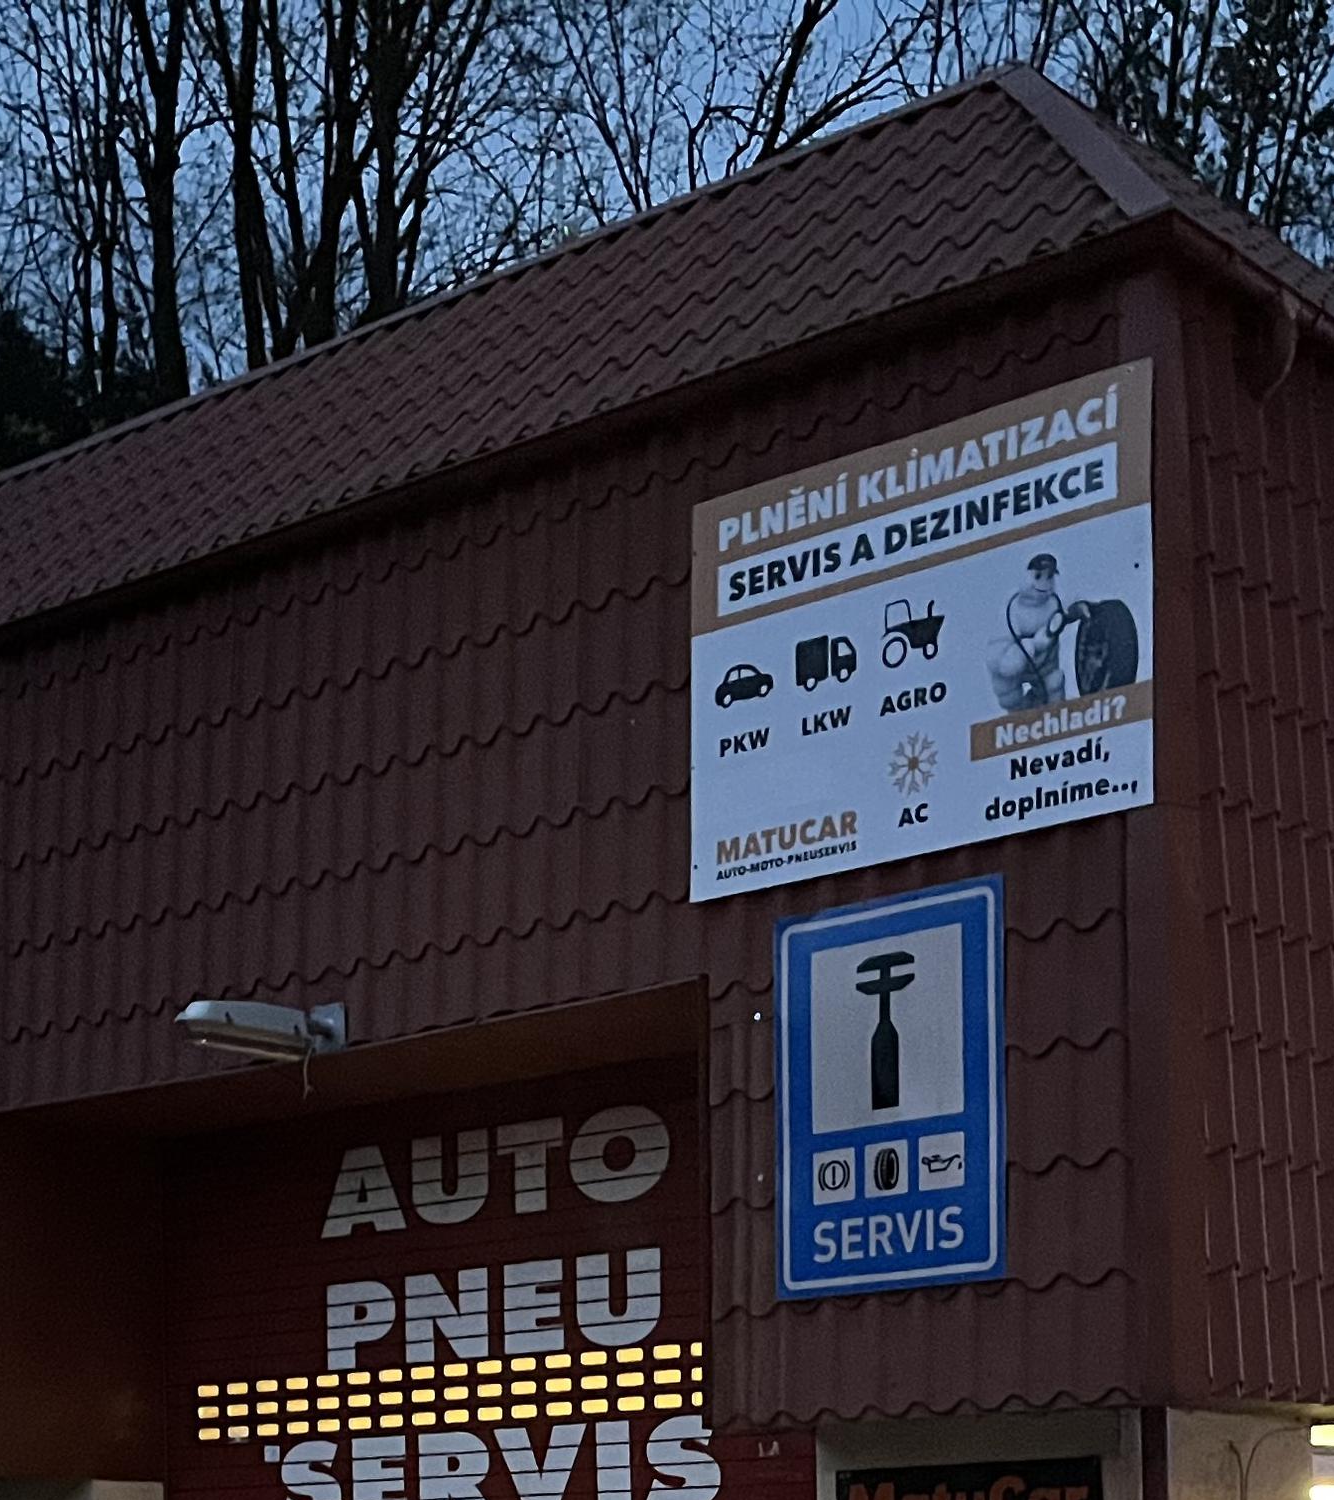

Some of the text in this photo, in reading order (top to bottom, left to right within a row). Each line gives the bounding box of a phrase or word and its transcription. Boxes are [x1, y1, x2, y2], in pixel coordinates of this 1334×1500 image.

[718, 383, 1120, 552] PLNĚNÍ KLIMATIZACÍ
[728, 459, 1105, 602] SERVIS A DEZINFEKCE
[801, 705, 853, 737] LKW
[879, 682, 948, 717] AGRO
[994, 695, 1127, 749] Nechladí?
[719, 727, 771, 758] PKW
[1010, 737, 1110, 780] Nevadí,
[716, 810, 858, 865] MATUCAR
[898, 803, 930, 829] AC
[320, 1105, 670, 1239] AUTO
[813, 1206, 965, 1263] SERVIS
[326, 1247, 661, 1371] PNEU
